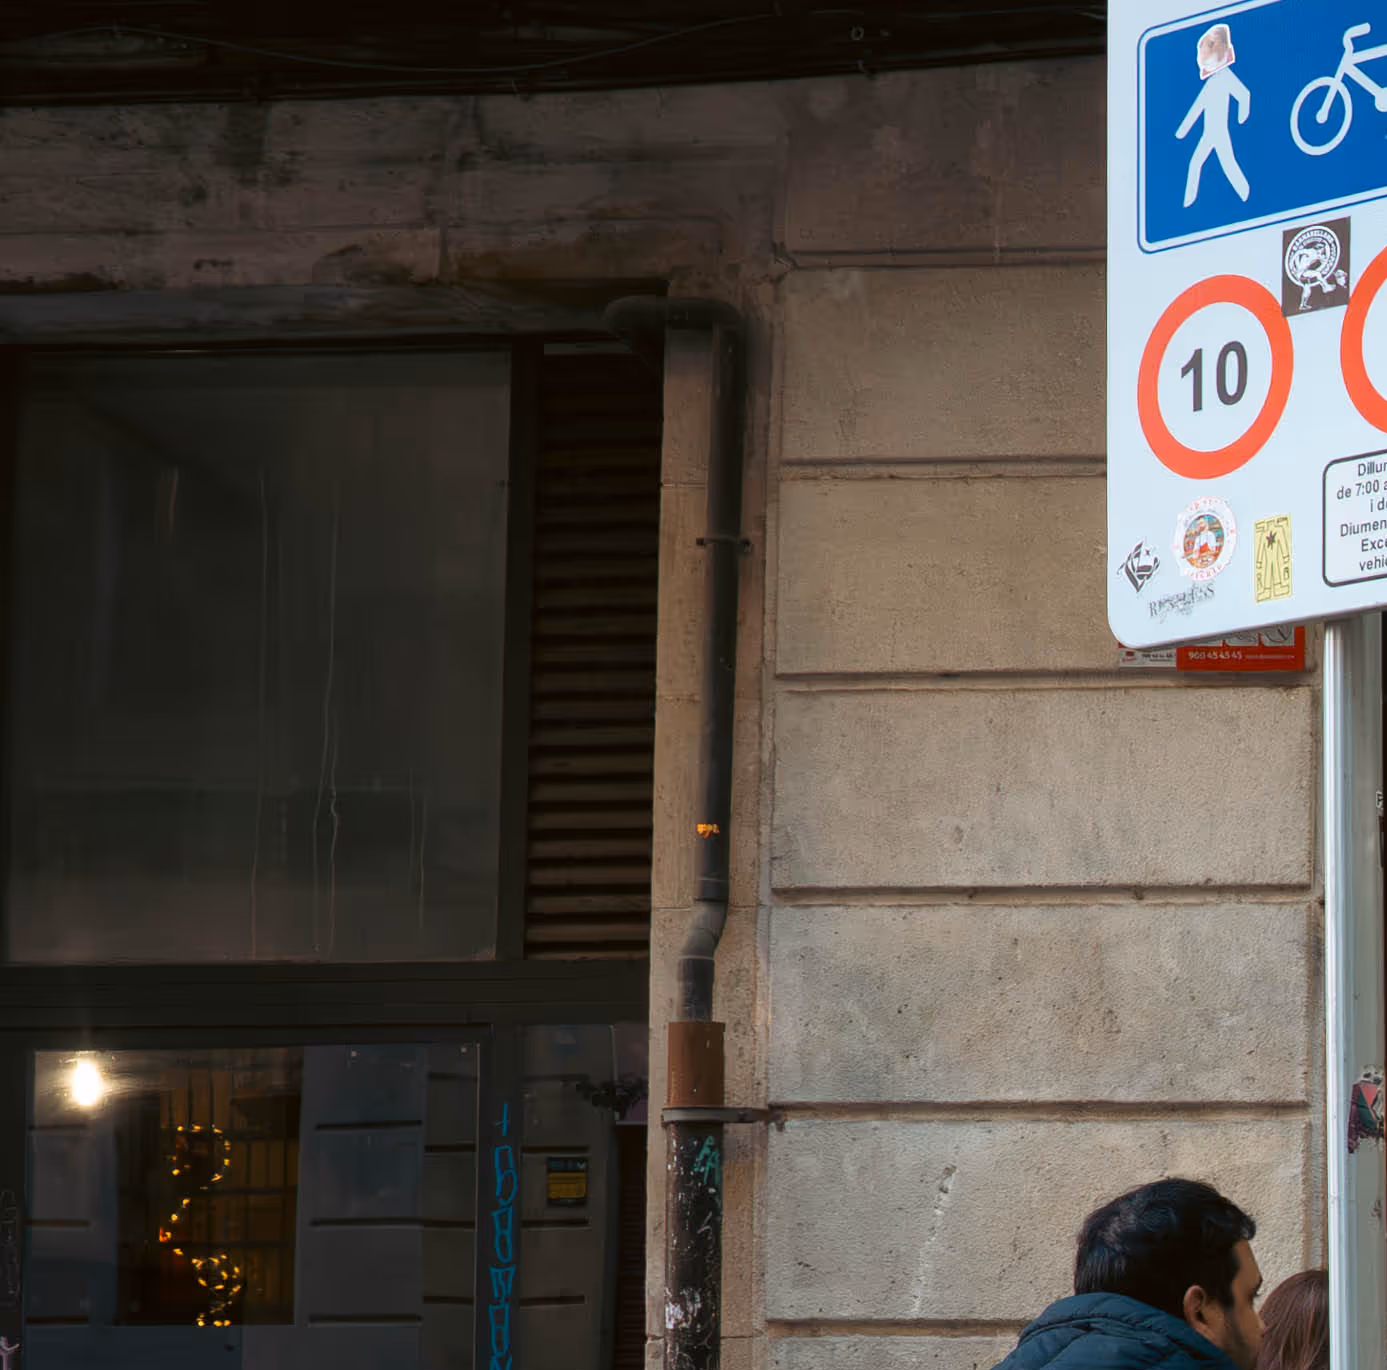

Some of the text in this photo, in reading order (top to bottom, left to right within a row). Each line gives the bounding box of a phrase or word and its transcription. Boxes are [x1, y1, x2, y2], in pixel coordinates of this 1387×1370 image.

[1180, 340, 1248, 412] 10
[1336, 486, 1352, 500] de
[1355, 479, 1379, 497] 7:00
[1370, 499, 1374, 513] i
